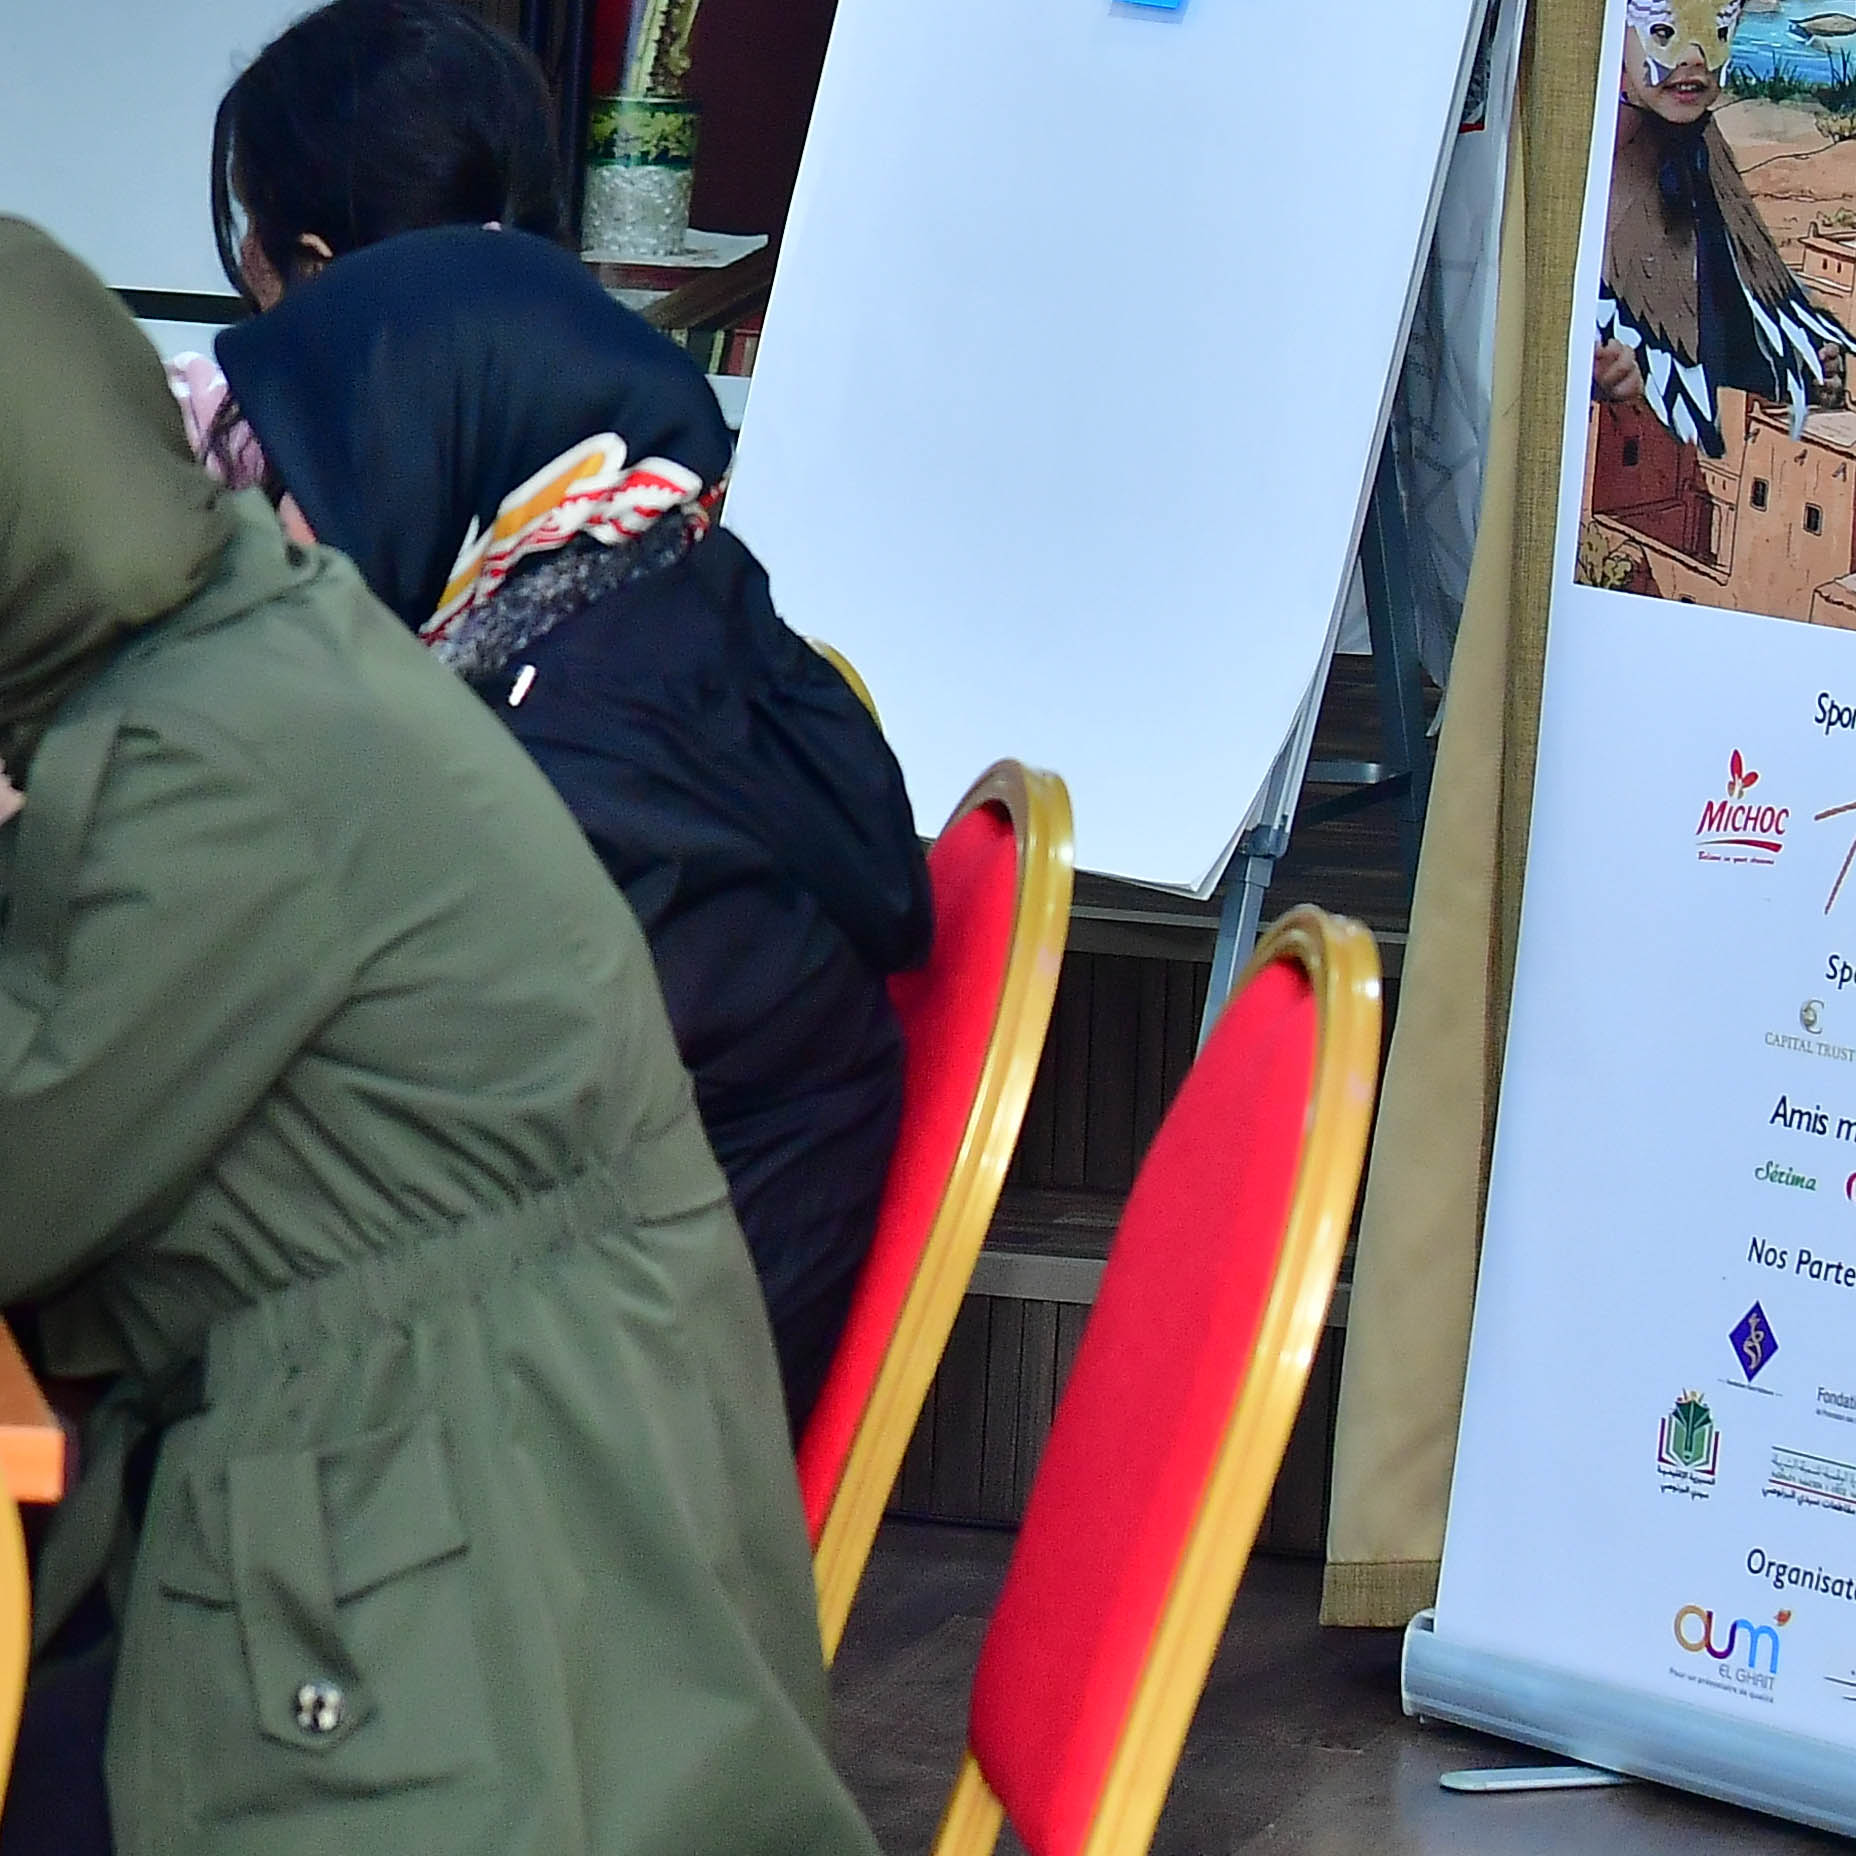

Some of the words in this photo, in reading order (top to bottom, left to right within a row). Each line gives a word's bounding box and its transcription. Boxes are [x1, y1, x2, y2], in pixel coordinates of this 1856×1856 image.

[1696, 800, 1790, 835] MICHOC
[1764, 1031, 1813, 1054] CAPITAL
[1816, 1041, 1856, 1062] TRUST
[1769, 1095, 1829, 1135] Amis
[1747, 1236, 1788, 1269] Nos
[1795, 1249, 1856, 1287] Parte
